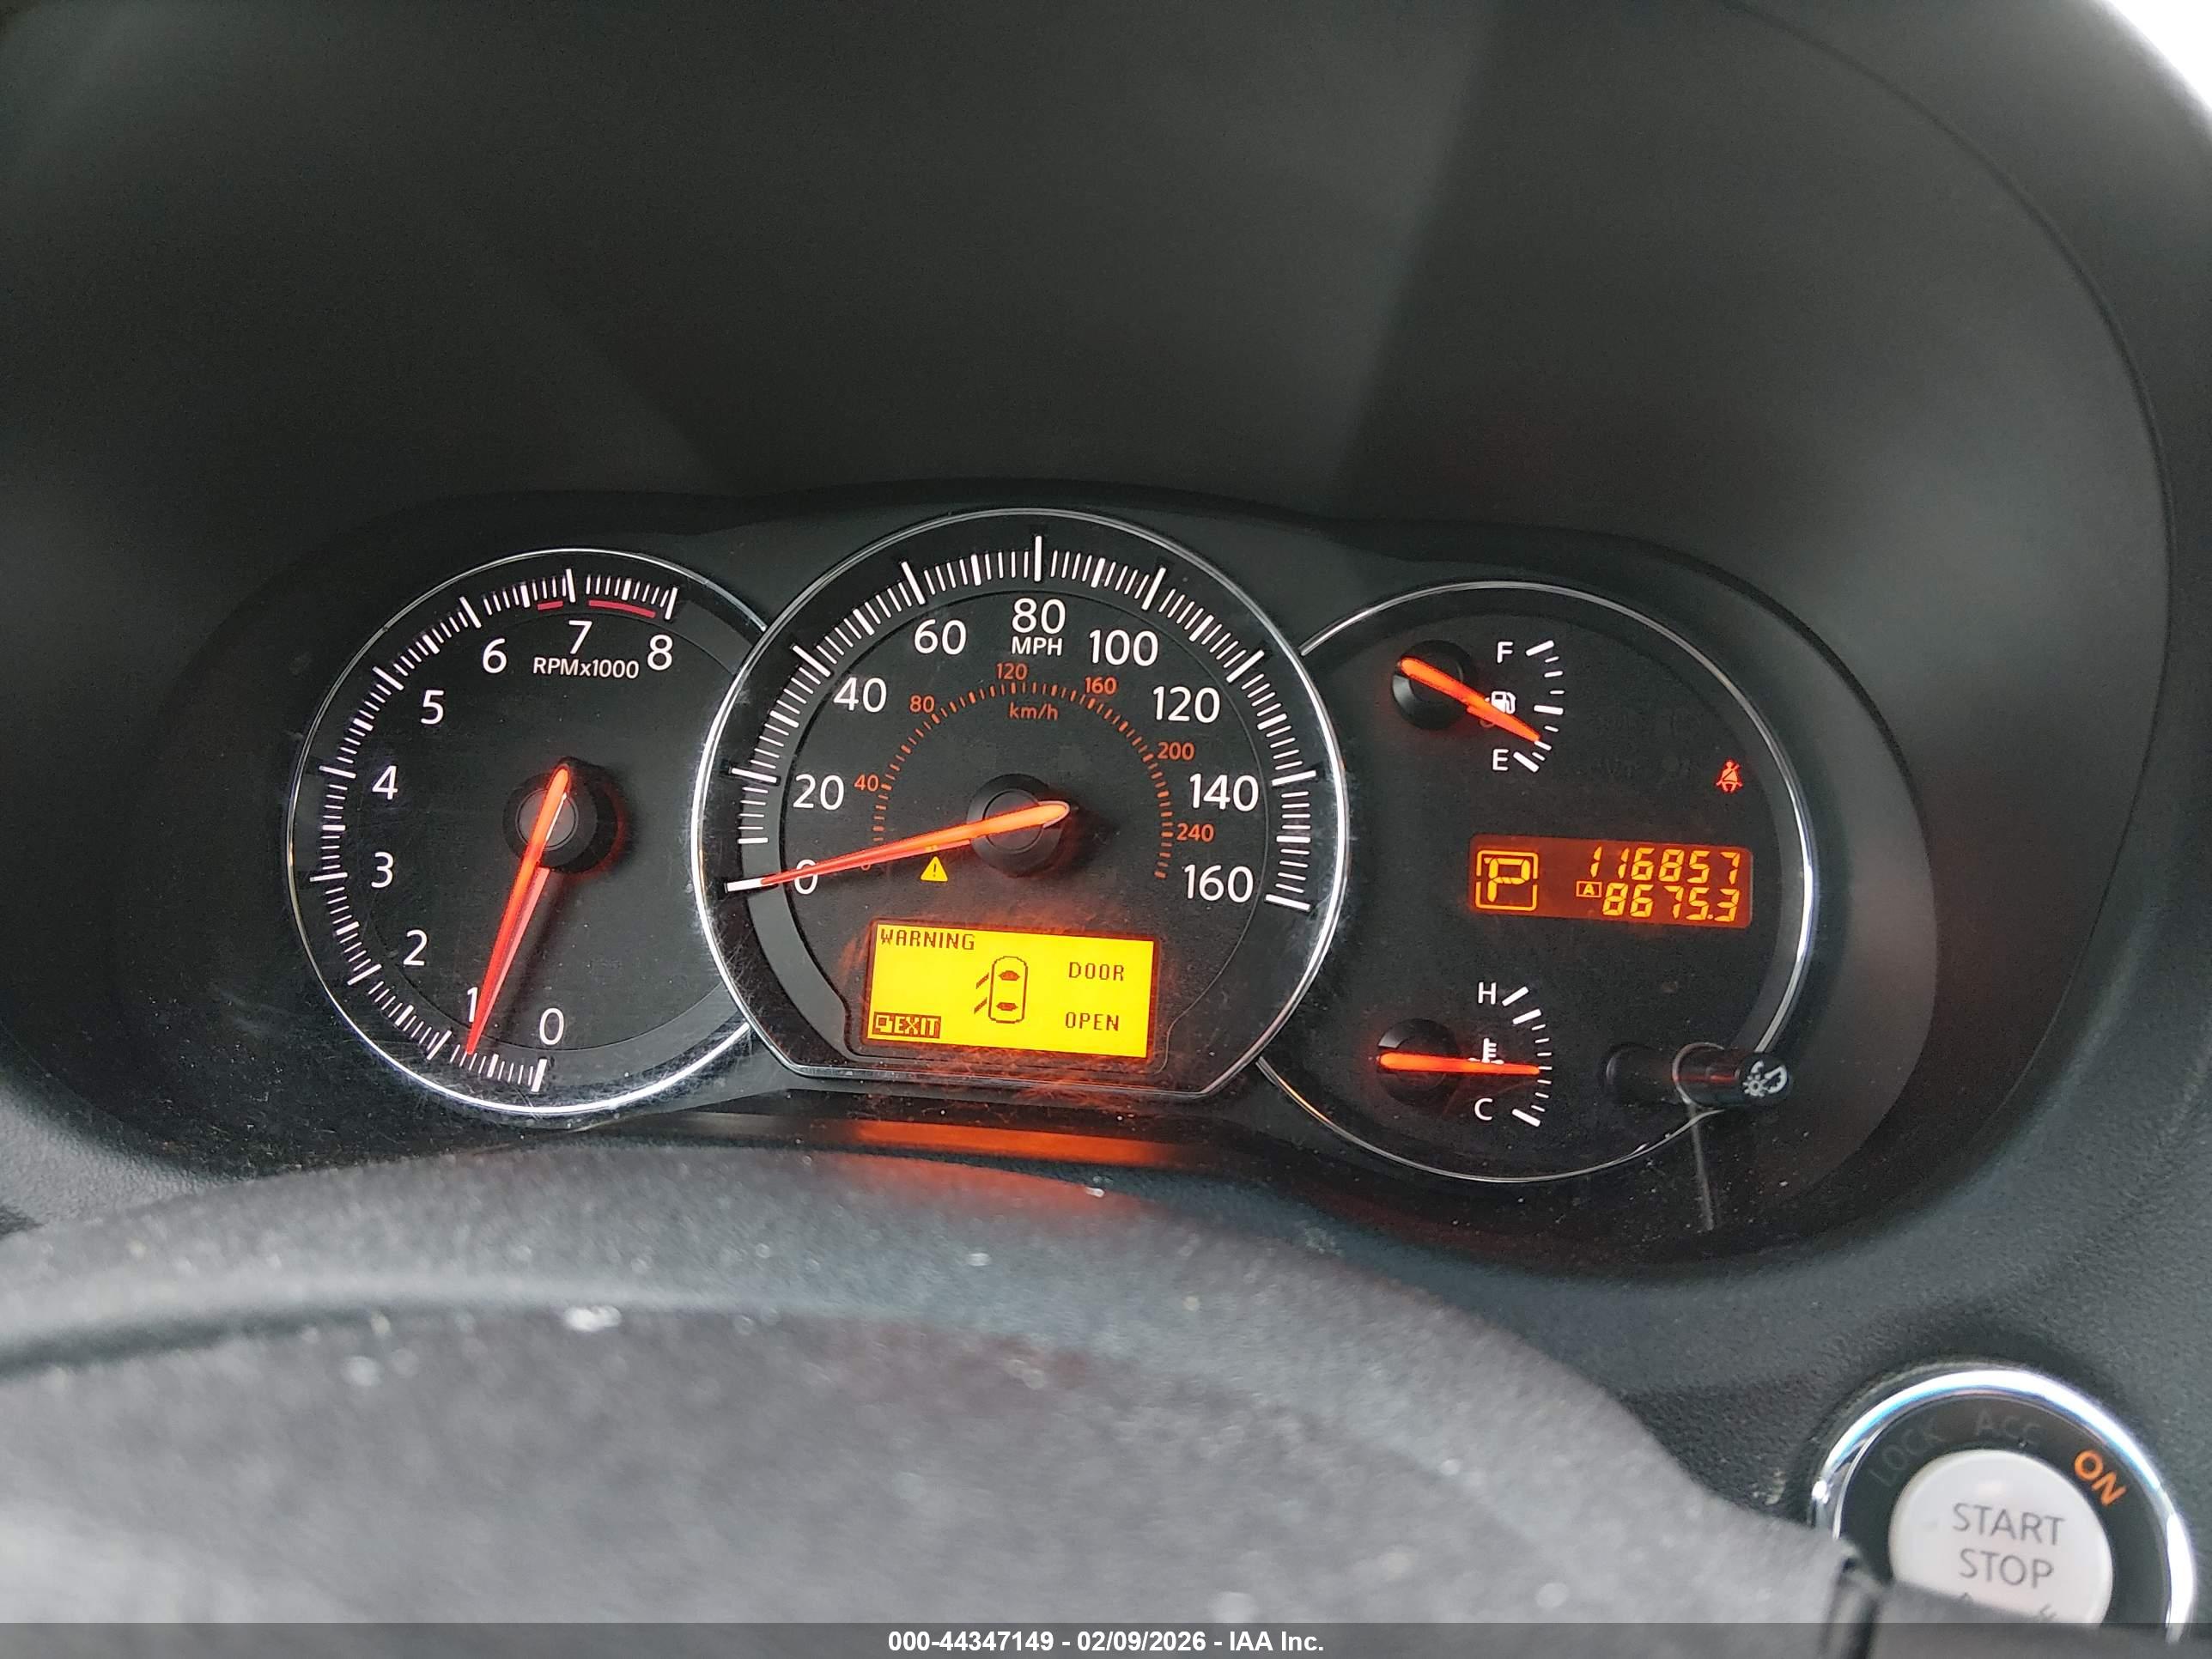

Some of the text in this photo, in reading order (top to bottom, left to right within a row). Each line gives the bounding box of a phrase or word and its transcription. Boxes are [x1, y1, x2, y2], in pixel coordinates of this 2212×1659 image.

[1012, 599, 1066, 634] 80
[568, 620, 592, 653] 7
[647, 635, 673, 670] 8
[914, 619, 967, 655] 60
[1012, 636, 1063, 655] MPH
[1089, 629, 1158, 667] 100
[1497, 641, 1513, 663] F
[482, 638, 507, 674] 6
[532, 656, 640, 679] RPMx1000
[996, 663, 1027, 681] 120
[833, 677, 887, 713] 40
[909, 695, 935, 713] 80
[1085, 677, 1117, 696] 160
[420, 690, 444, 725] 5
[1008, 702, 1059, 720] km/h
[1152, 685, 1220, 724] 120
[1158, 741, 1195, 761] 200
[1493, 749, 1509, 770] E
[372, 765, 398, 799] 4
[793, 774, 845, 810] 20
[854, 773, 879, 792] 40
[1189, 774, 1259, 811] 140
[1176, 823, 1214, 842] 240
[371, 851, 393, 888] 3
[1484, 857, 1531, 902] P
[1589, 845, 1741, 884] 116857
[1182, 864, 1254, 903] 160
[1601, 882, 1740, 921] 8675.3
[403, 929, 427, 966] 2
[880, 928, 975, 951] WARNING
[1068, 962, 1125, 981] DOOR
[466, 987, 478, 1023] 1
[1478, 982, 1496, 1004] H
[539, 1007, 564, 1045] 0
[896, 1017, 939, 1036] EXIT
[1065, 1012, 1120, 1031] OPEN
[1474, 1098, 1493, 1120] C
[2074, 1449, 2127, 1506] ON
[1953, 1503, 2065, 1545] START
[1959, 1548, 2054, 1588] STOP
